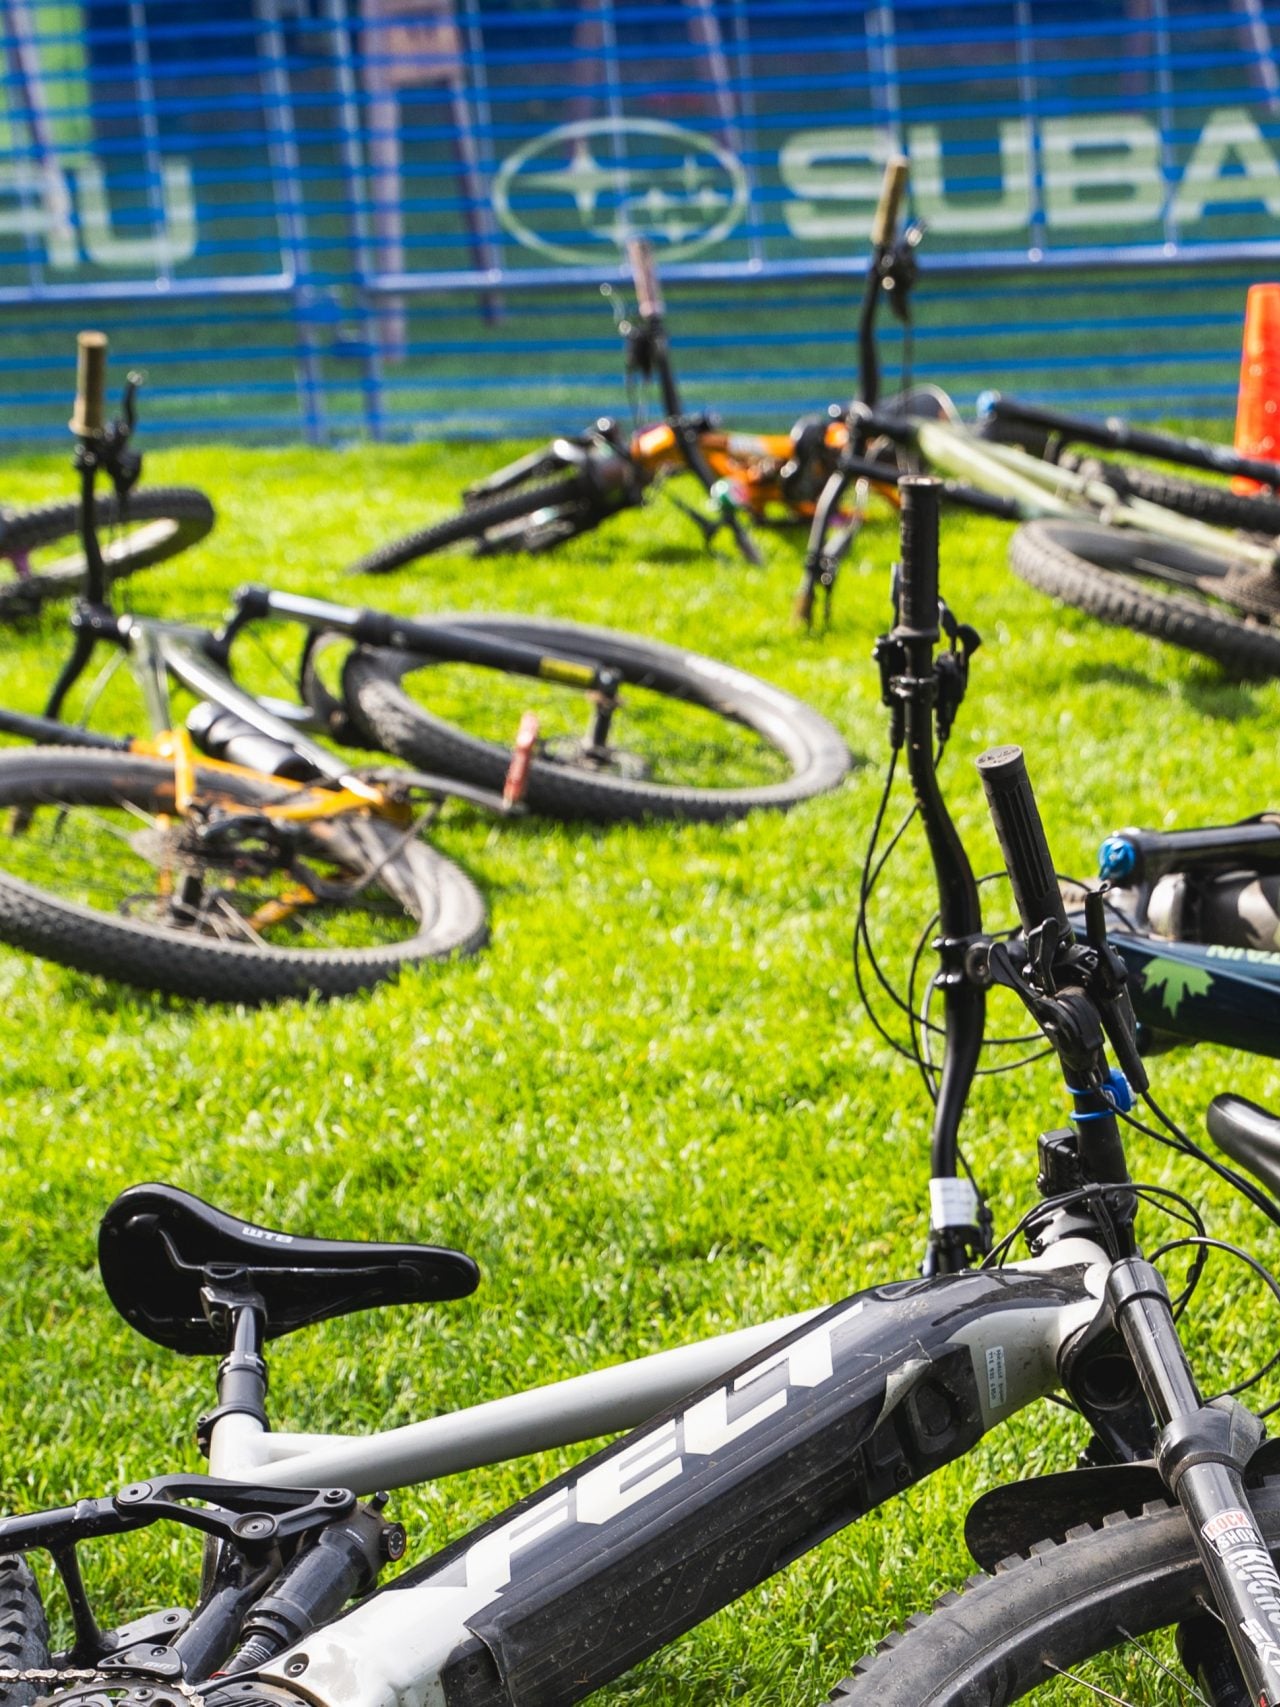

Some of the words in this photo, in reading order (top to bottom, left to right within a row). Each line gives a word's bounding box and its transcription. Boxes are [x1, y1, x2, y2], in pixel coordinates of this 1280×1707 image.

[242, 1226, 294, 1244] WTB
[465, 1300, 863, 1592] FELT
[1206, 1511, 1250, 1539] ROCK
